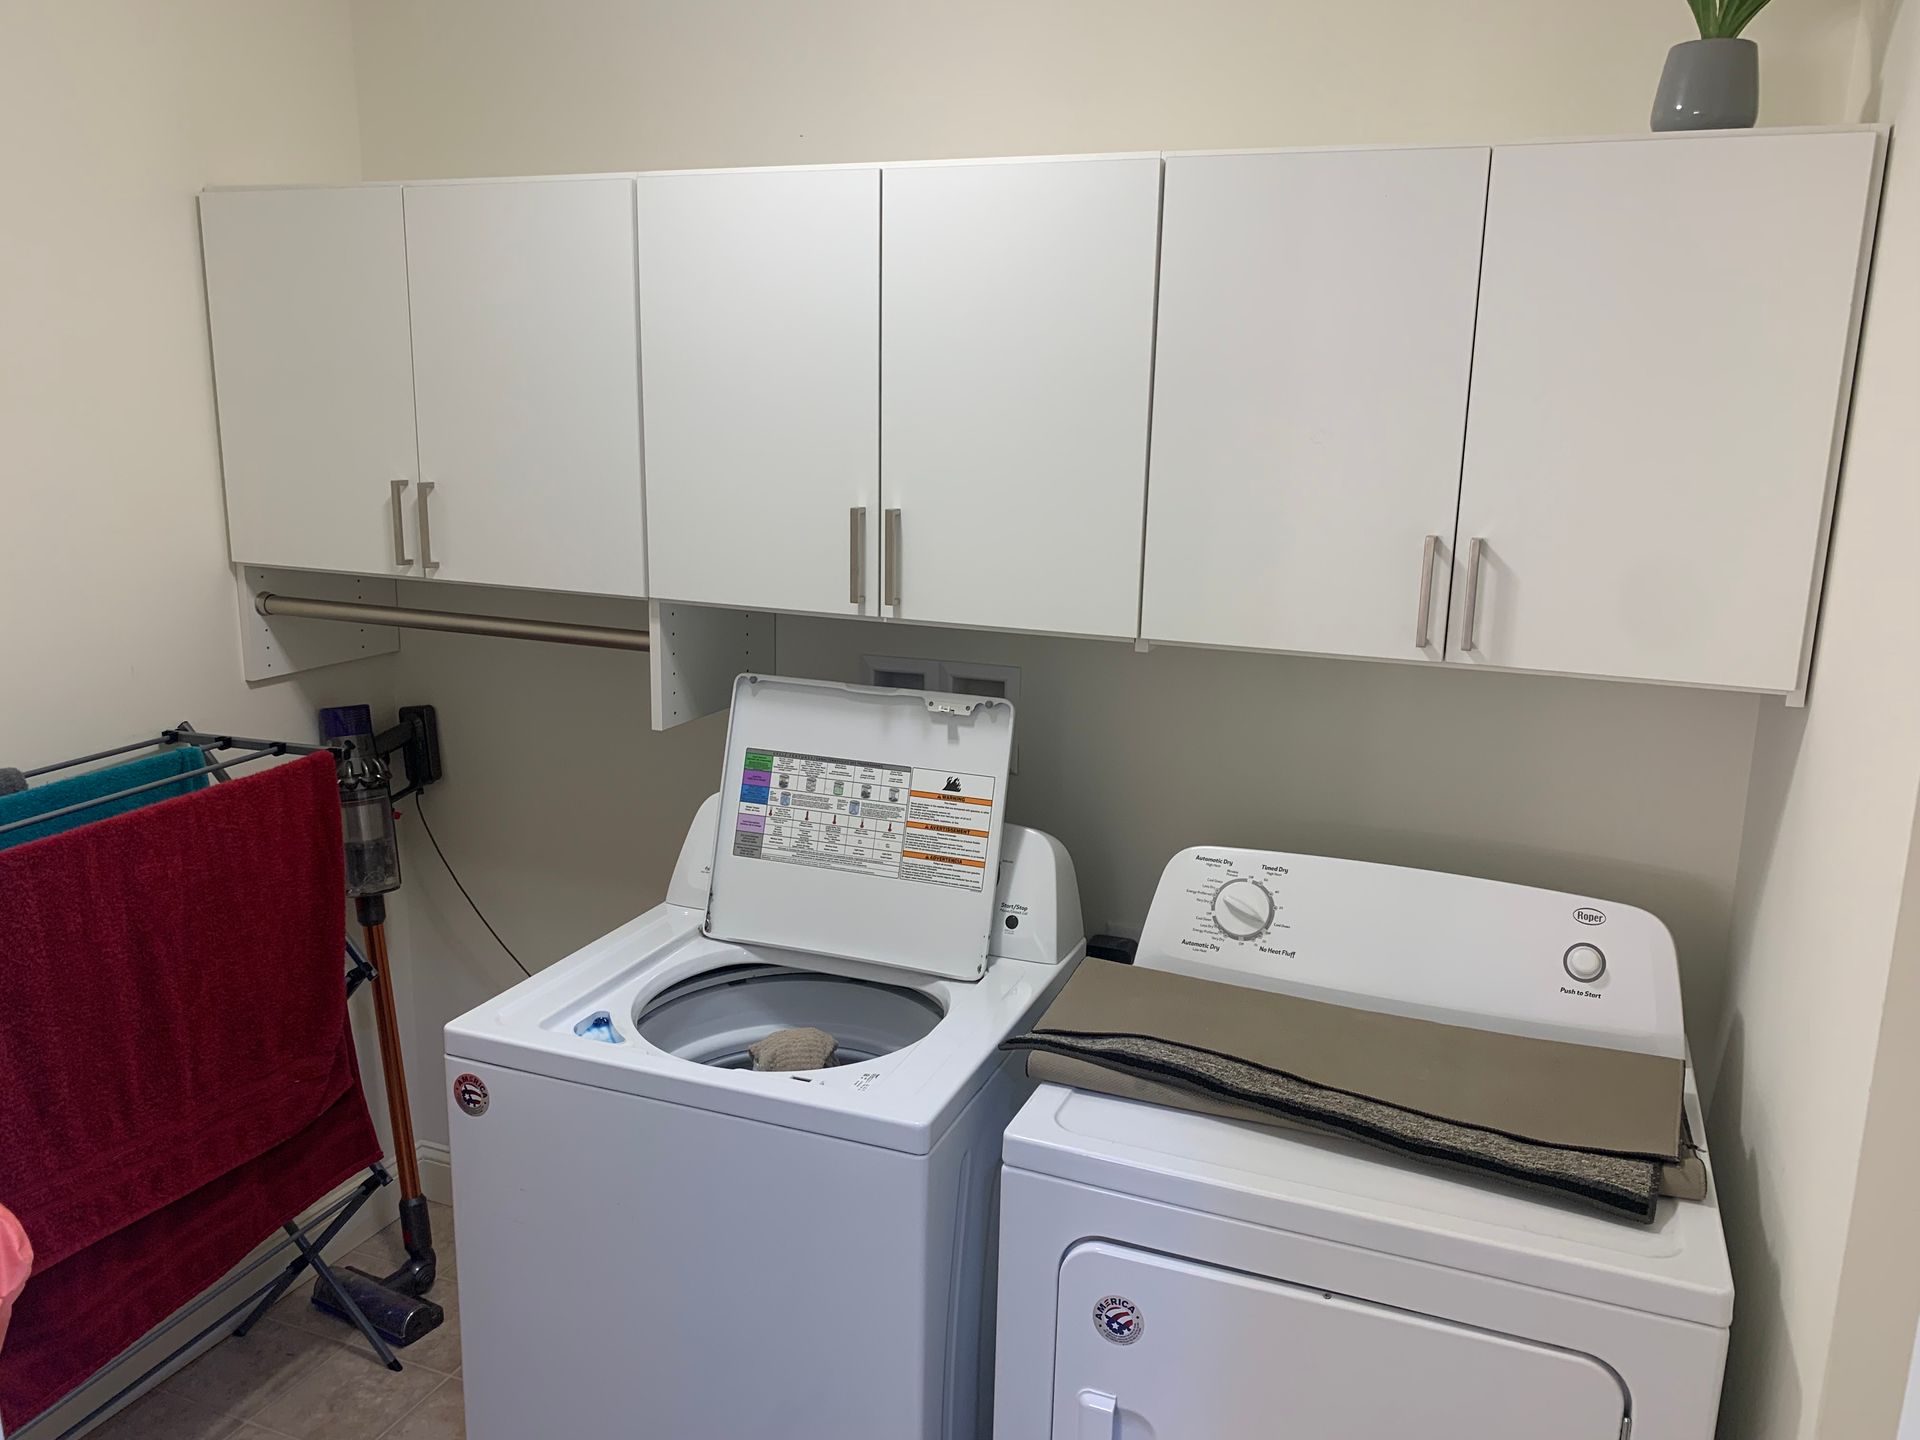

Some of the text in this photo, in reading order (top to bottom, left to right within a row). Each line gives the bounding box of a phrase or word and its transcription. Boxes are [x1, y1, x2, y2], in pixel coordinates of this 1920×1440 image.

[930, 826, 970, 834] AVERTISSEMENT
[930, 856, 963, 864] ADVERTENCIA
[1196, 855, 1222, 864] Automatic
[1001, 902, 1028, 911] Start/Stop
[1577, 911, 1603, 923] Roper
[1181, 939, 1220, 952] Automatic Dry
[1282, 950, 1296, 959] Fluff
[1560, 987, 1576, 995] Push
[1584, 991, 1602, 999] Start
[458, 1076, 488, 1098] AMERICA
[1095, 1298, 1136, 1320] AMERICA
